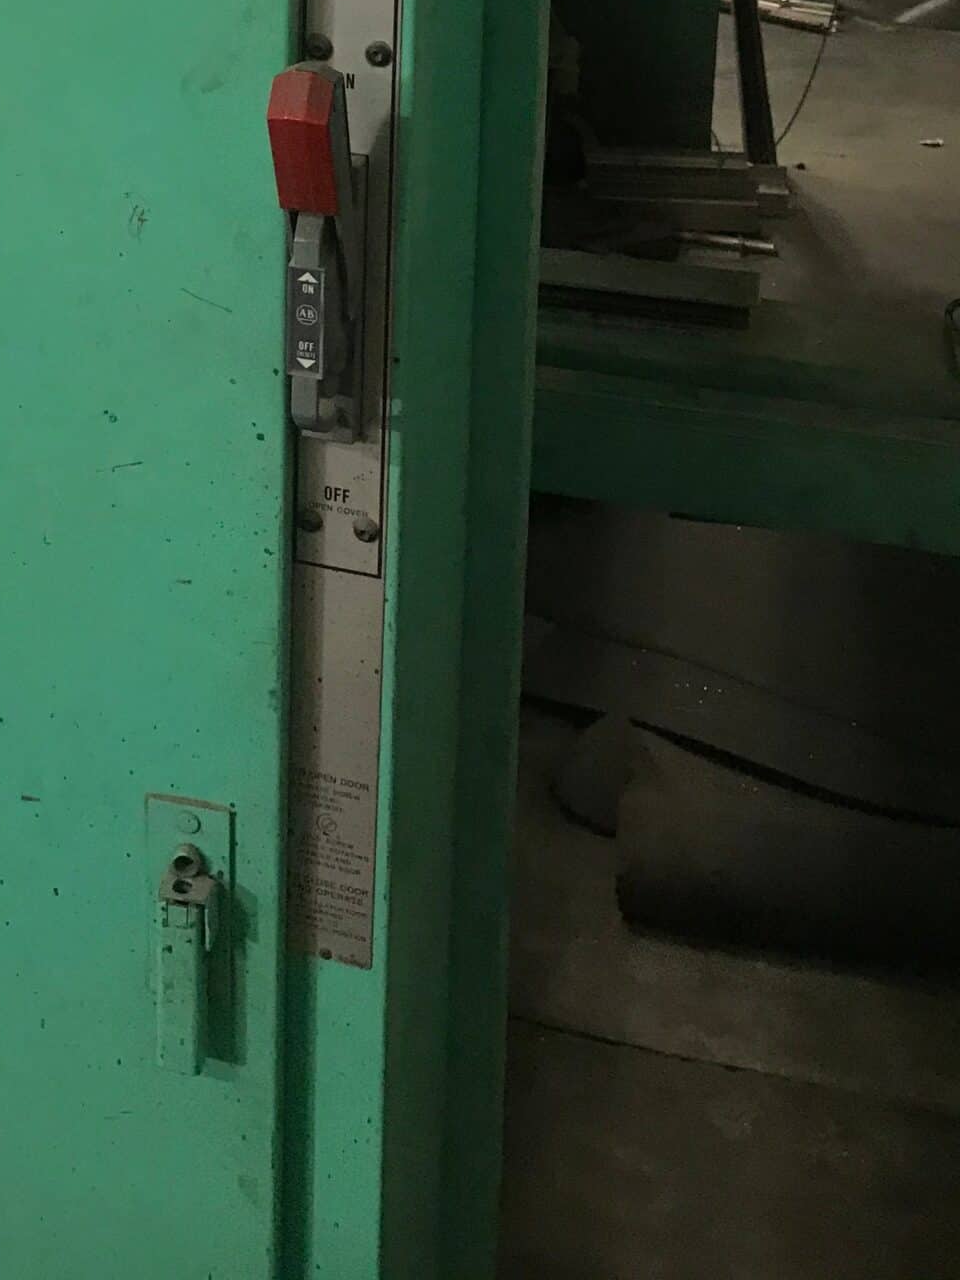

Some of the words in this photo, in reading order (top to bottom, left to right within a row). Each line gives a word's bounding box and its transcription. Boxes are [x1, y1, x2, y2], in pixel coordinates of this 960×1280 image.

[302, 283, 315, 295] ON
[298, 340, 315, 352] OFF
[324, 486, 350, 504] OFF
